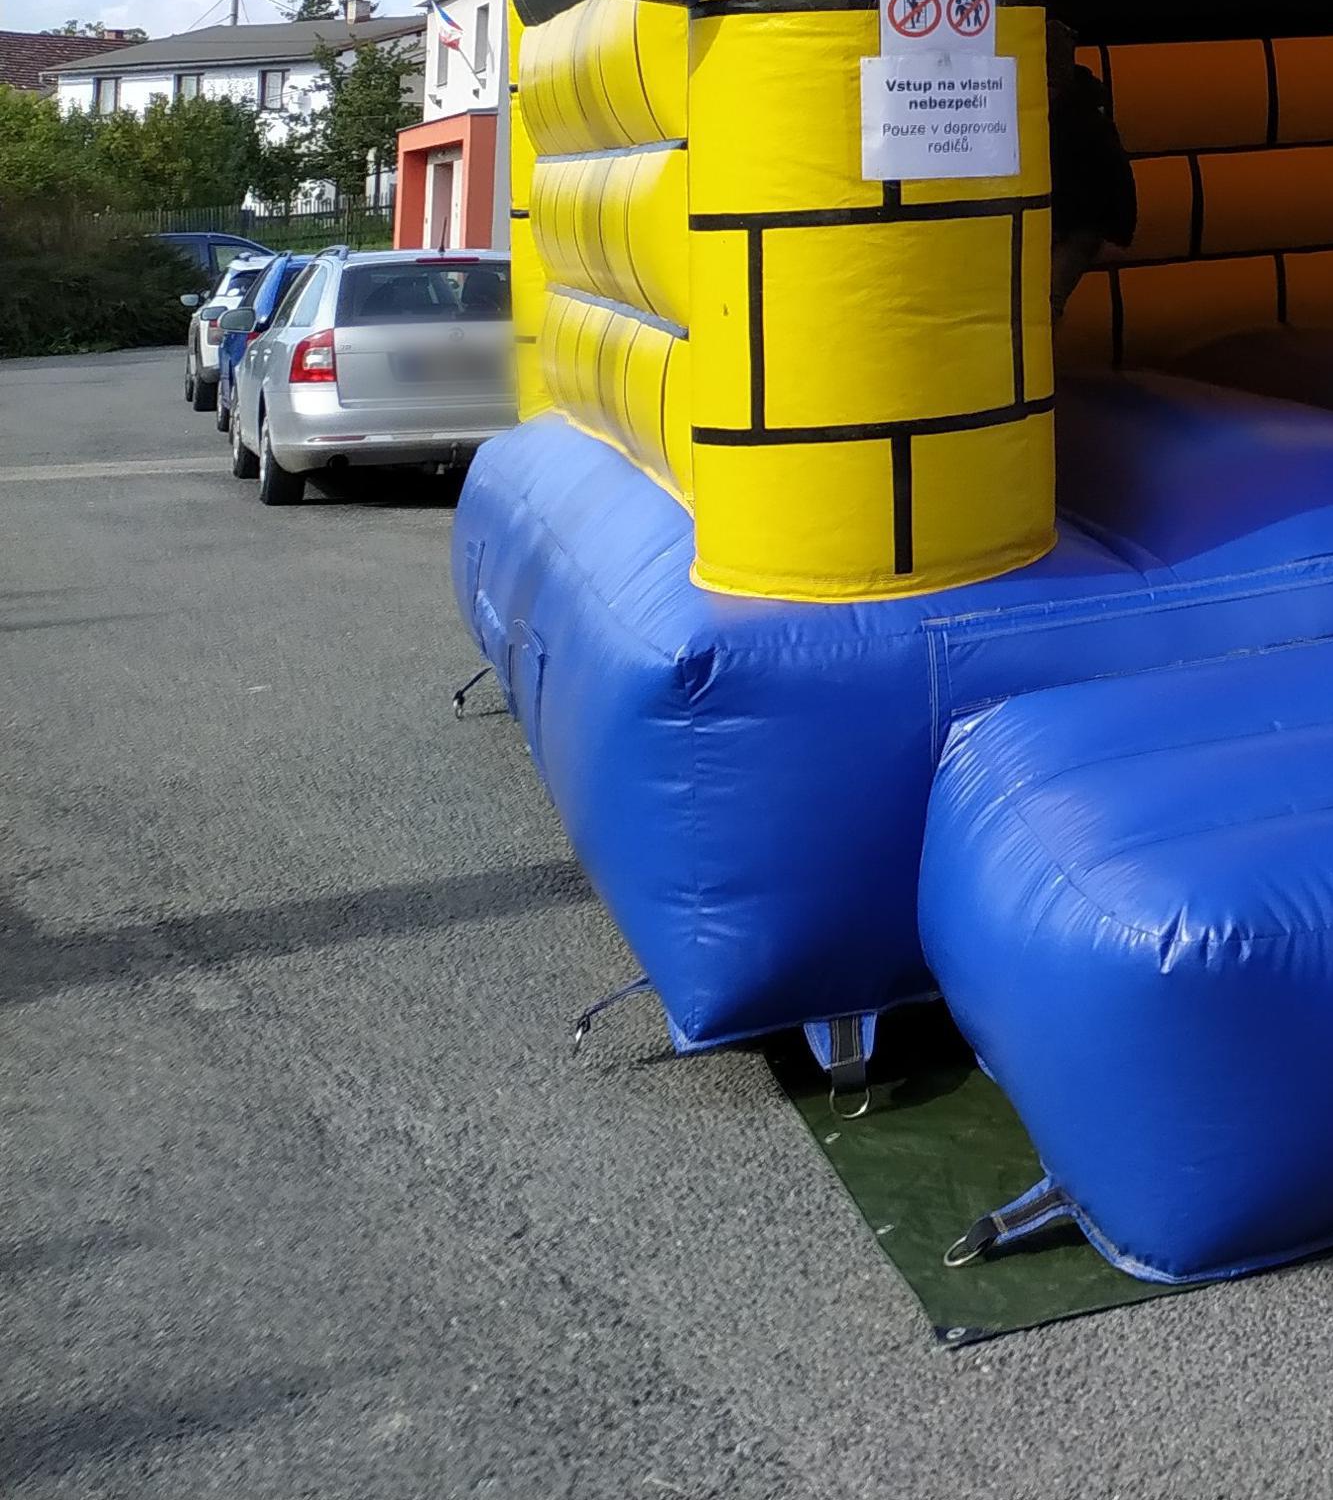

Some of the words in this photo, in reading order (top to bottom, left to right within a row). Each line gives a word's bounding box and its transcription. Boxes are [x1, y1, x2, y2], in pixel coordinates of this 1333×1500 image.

[885, 79, 932, 94] Vstup
[937, 80, 955, 91] na
[882, 123, 926, 137] Pouze
[931, 124, 939, 134] v
